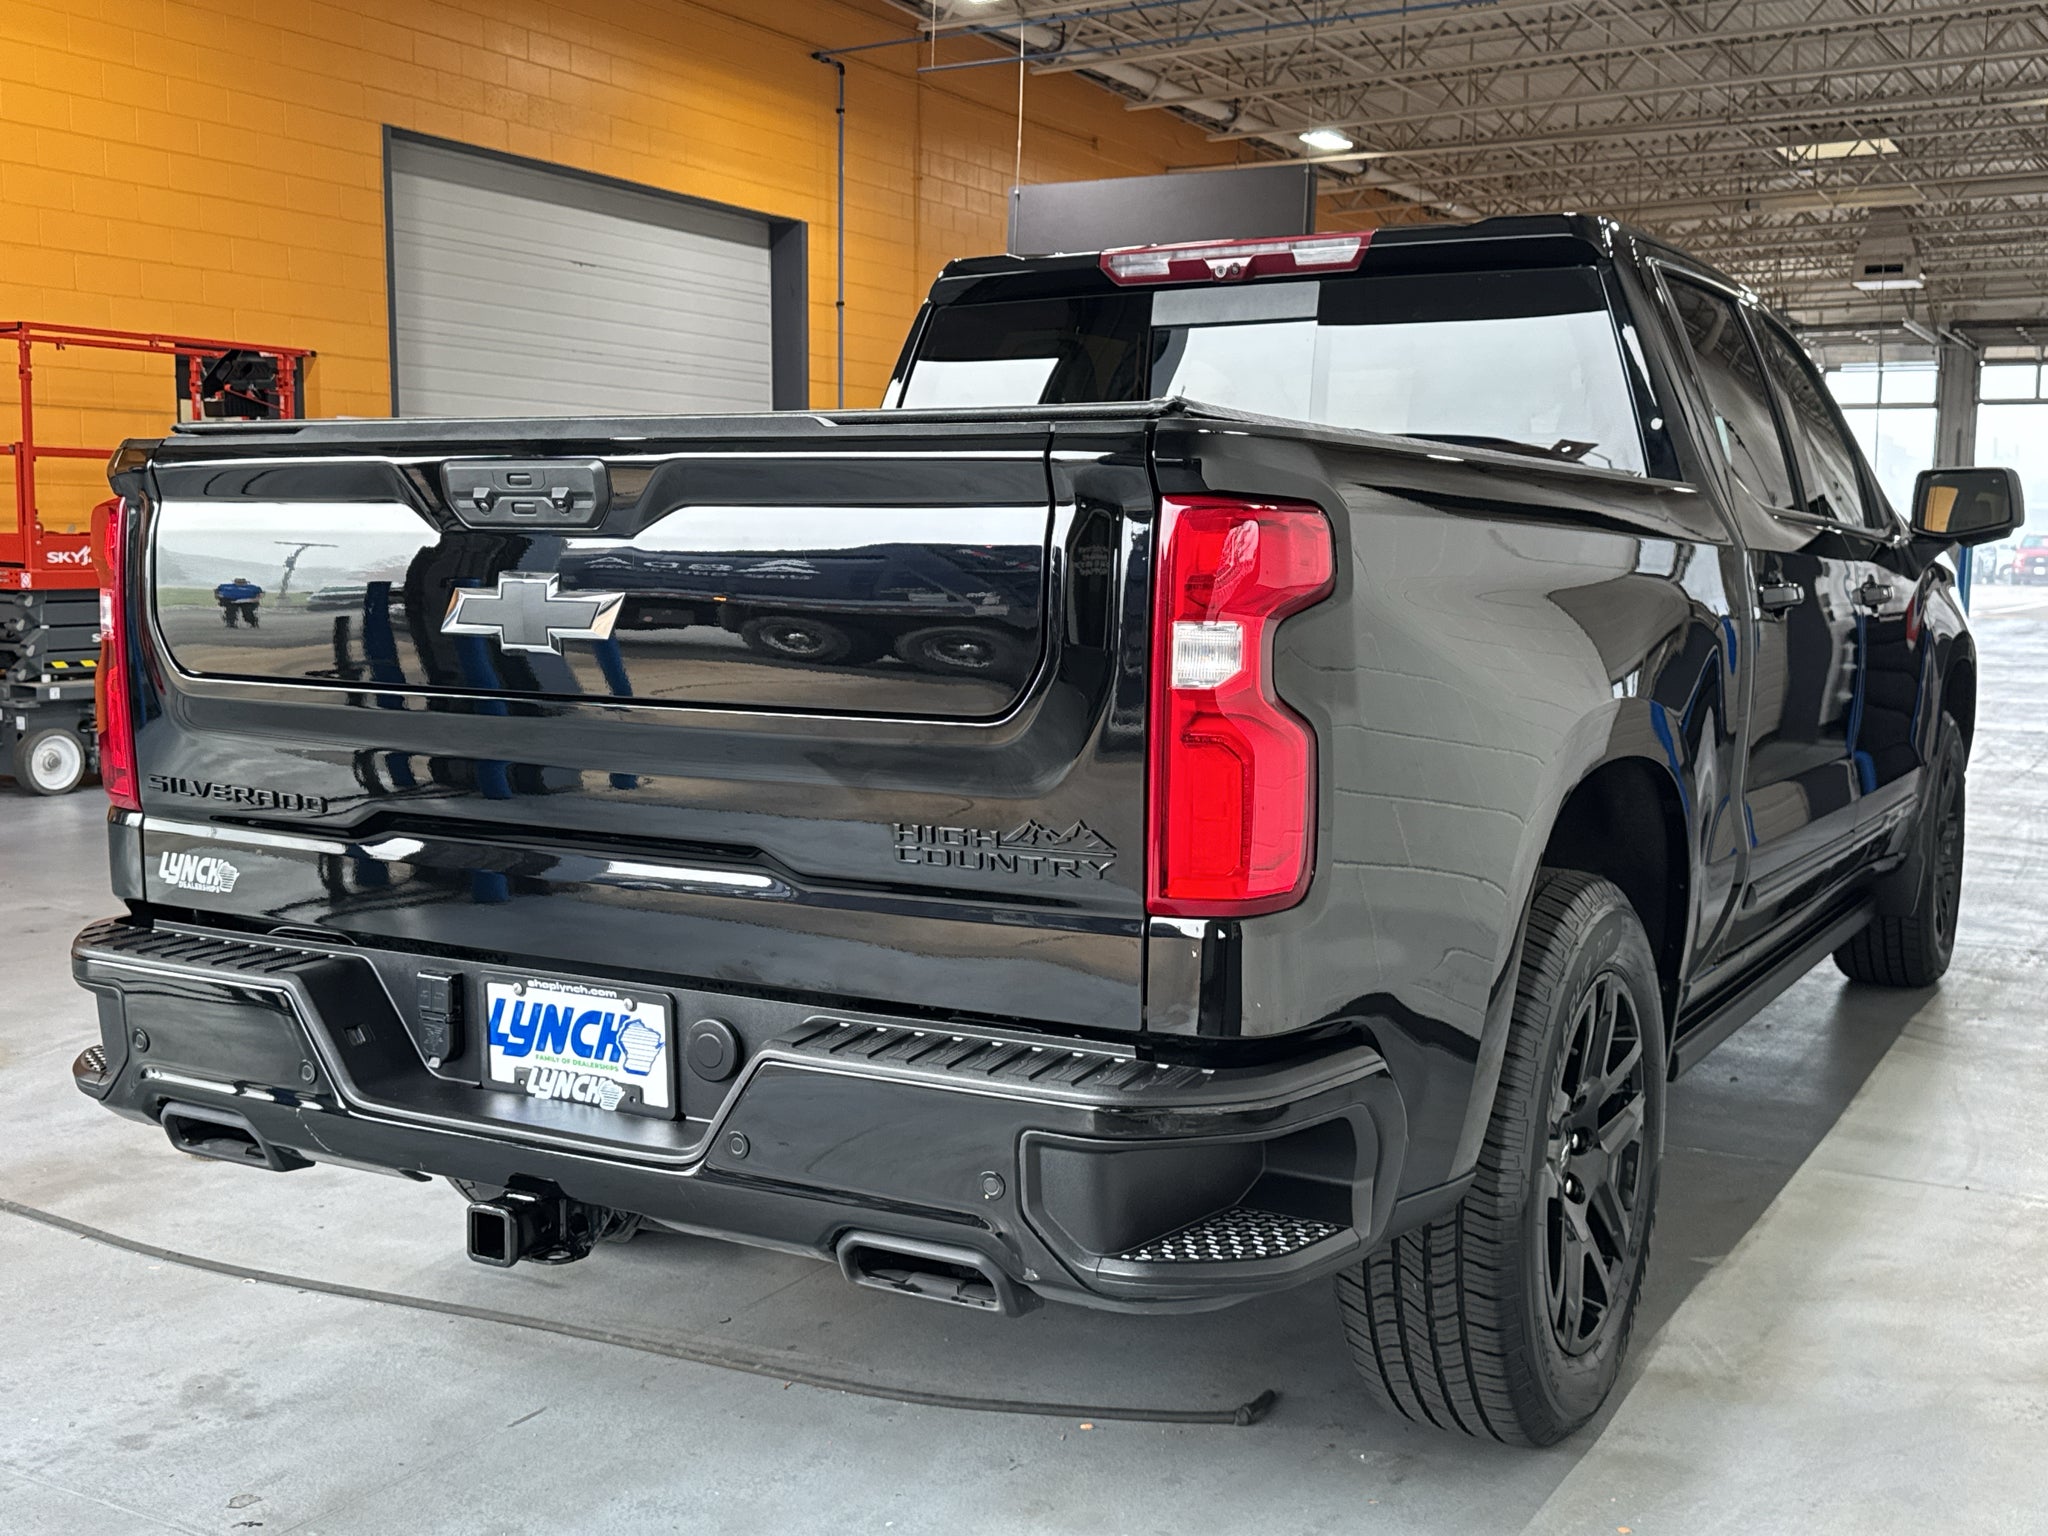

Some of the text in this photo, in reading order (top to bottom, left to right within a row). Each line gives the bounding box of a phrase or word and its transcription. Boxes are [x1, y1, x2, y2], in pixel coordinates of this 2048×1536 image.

[46, 545, 93, 566] SKYJ
[149, 774, 328, 814] SILVERADO
[892, 822, 1000, 849] HIGH
[159, 851, 224, 884] LYNCH
[894, 844, 1116, 880] COUNTRY
[527, 979, 617, 999] shoplynch.com
[489, 998, 631, 1063] LYNCH
[535, 1054, 560, 1063] FAMILY
[526, 1065, 606, 1104] LYNCH
